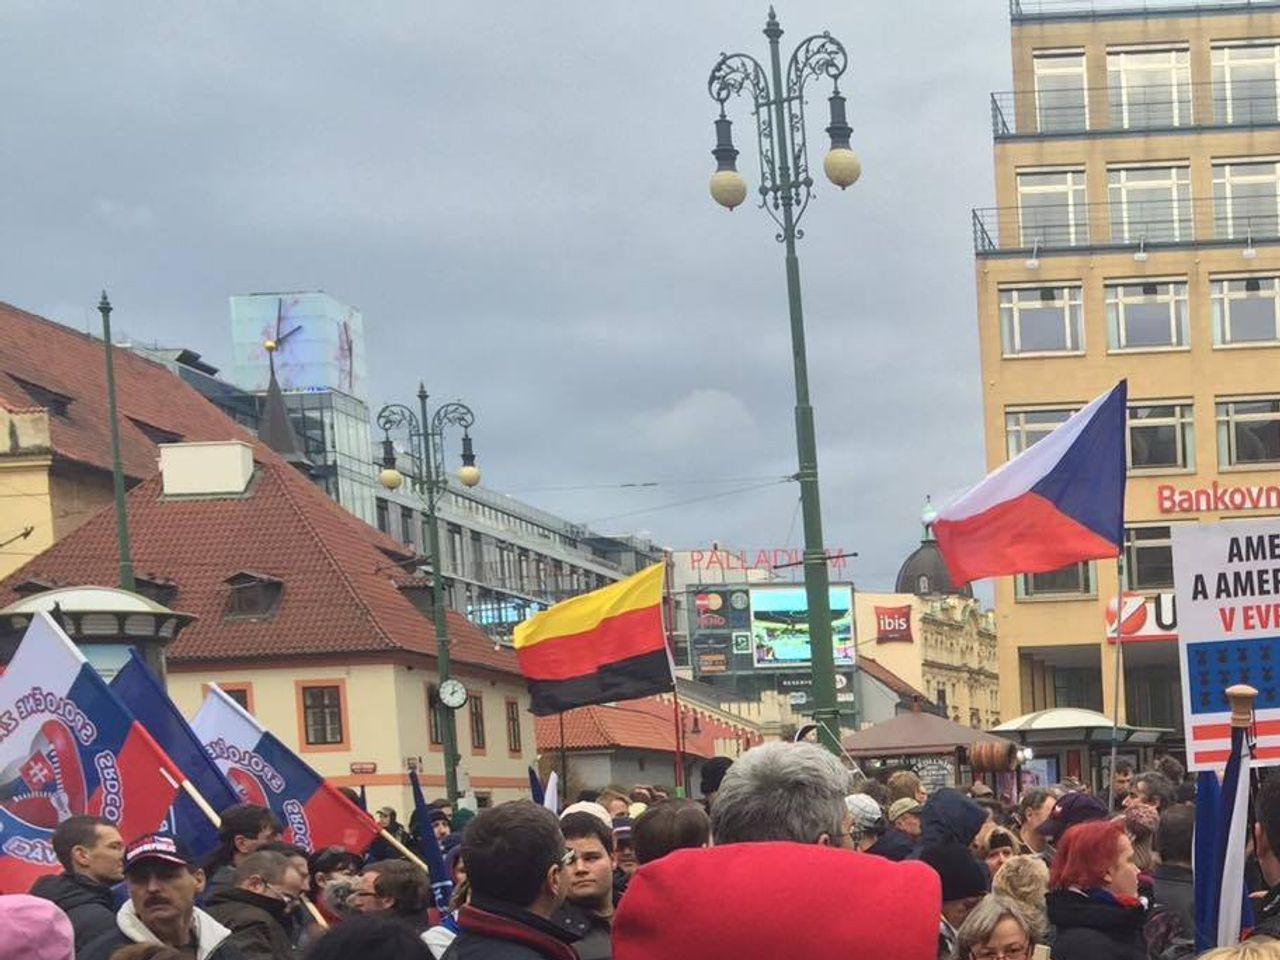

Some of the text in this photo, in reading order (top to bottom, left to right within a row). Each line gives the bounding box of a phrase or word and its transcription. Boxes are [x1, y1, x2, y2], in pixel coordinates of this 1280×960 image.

[690, 548, 847, 571] PALLADIM
[1191, 574, 1209, 601] A
[880, 615, 907, 630] ibis
[1218, 606, 1236, 632] V
